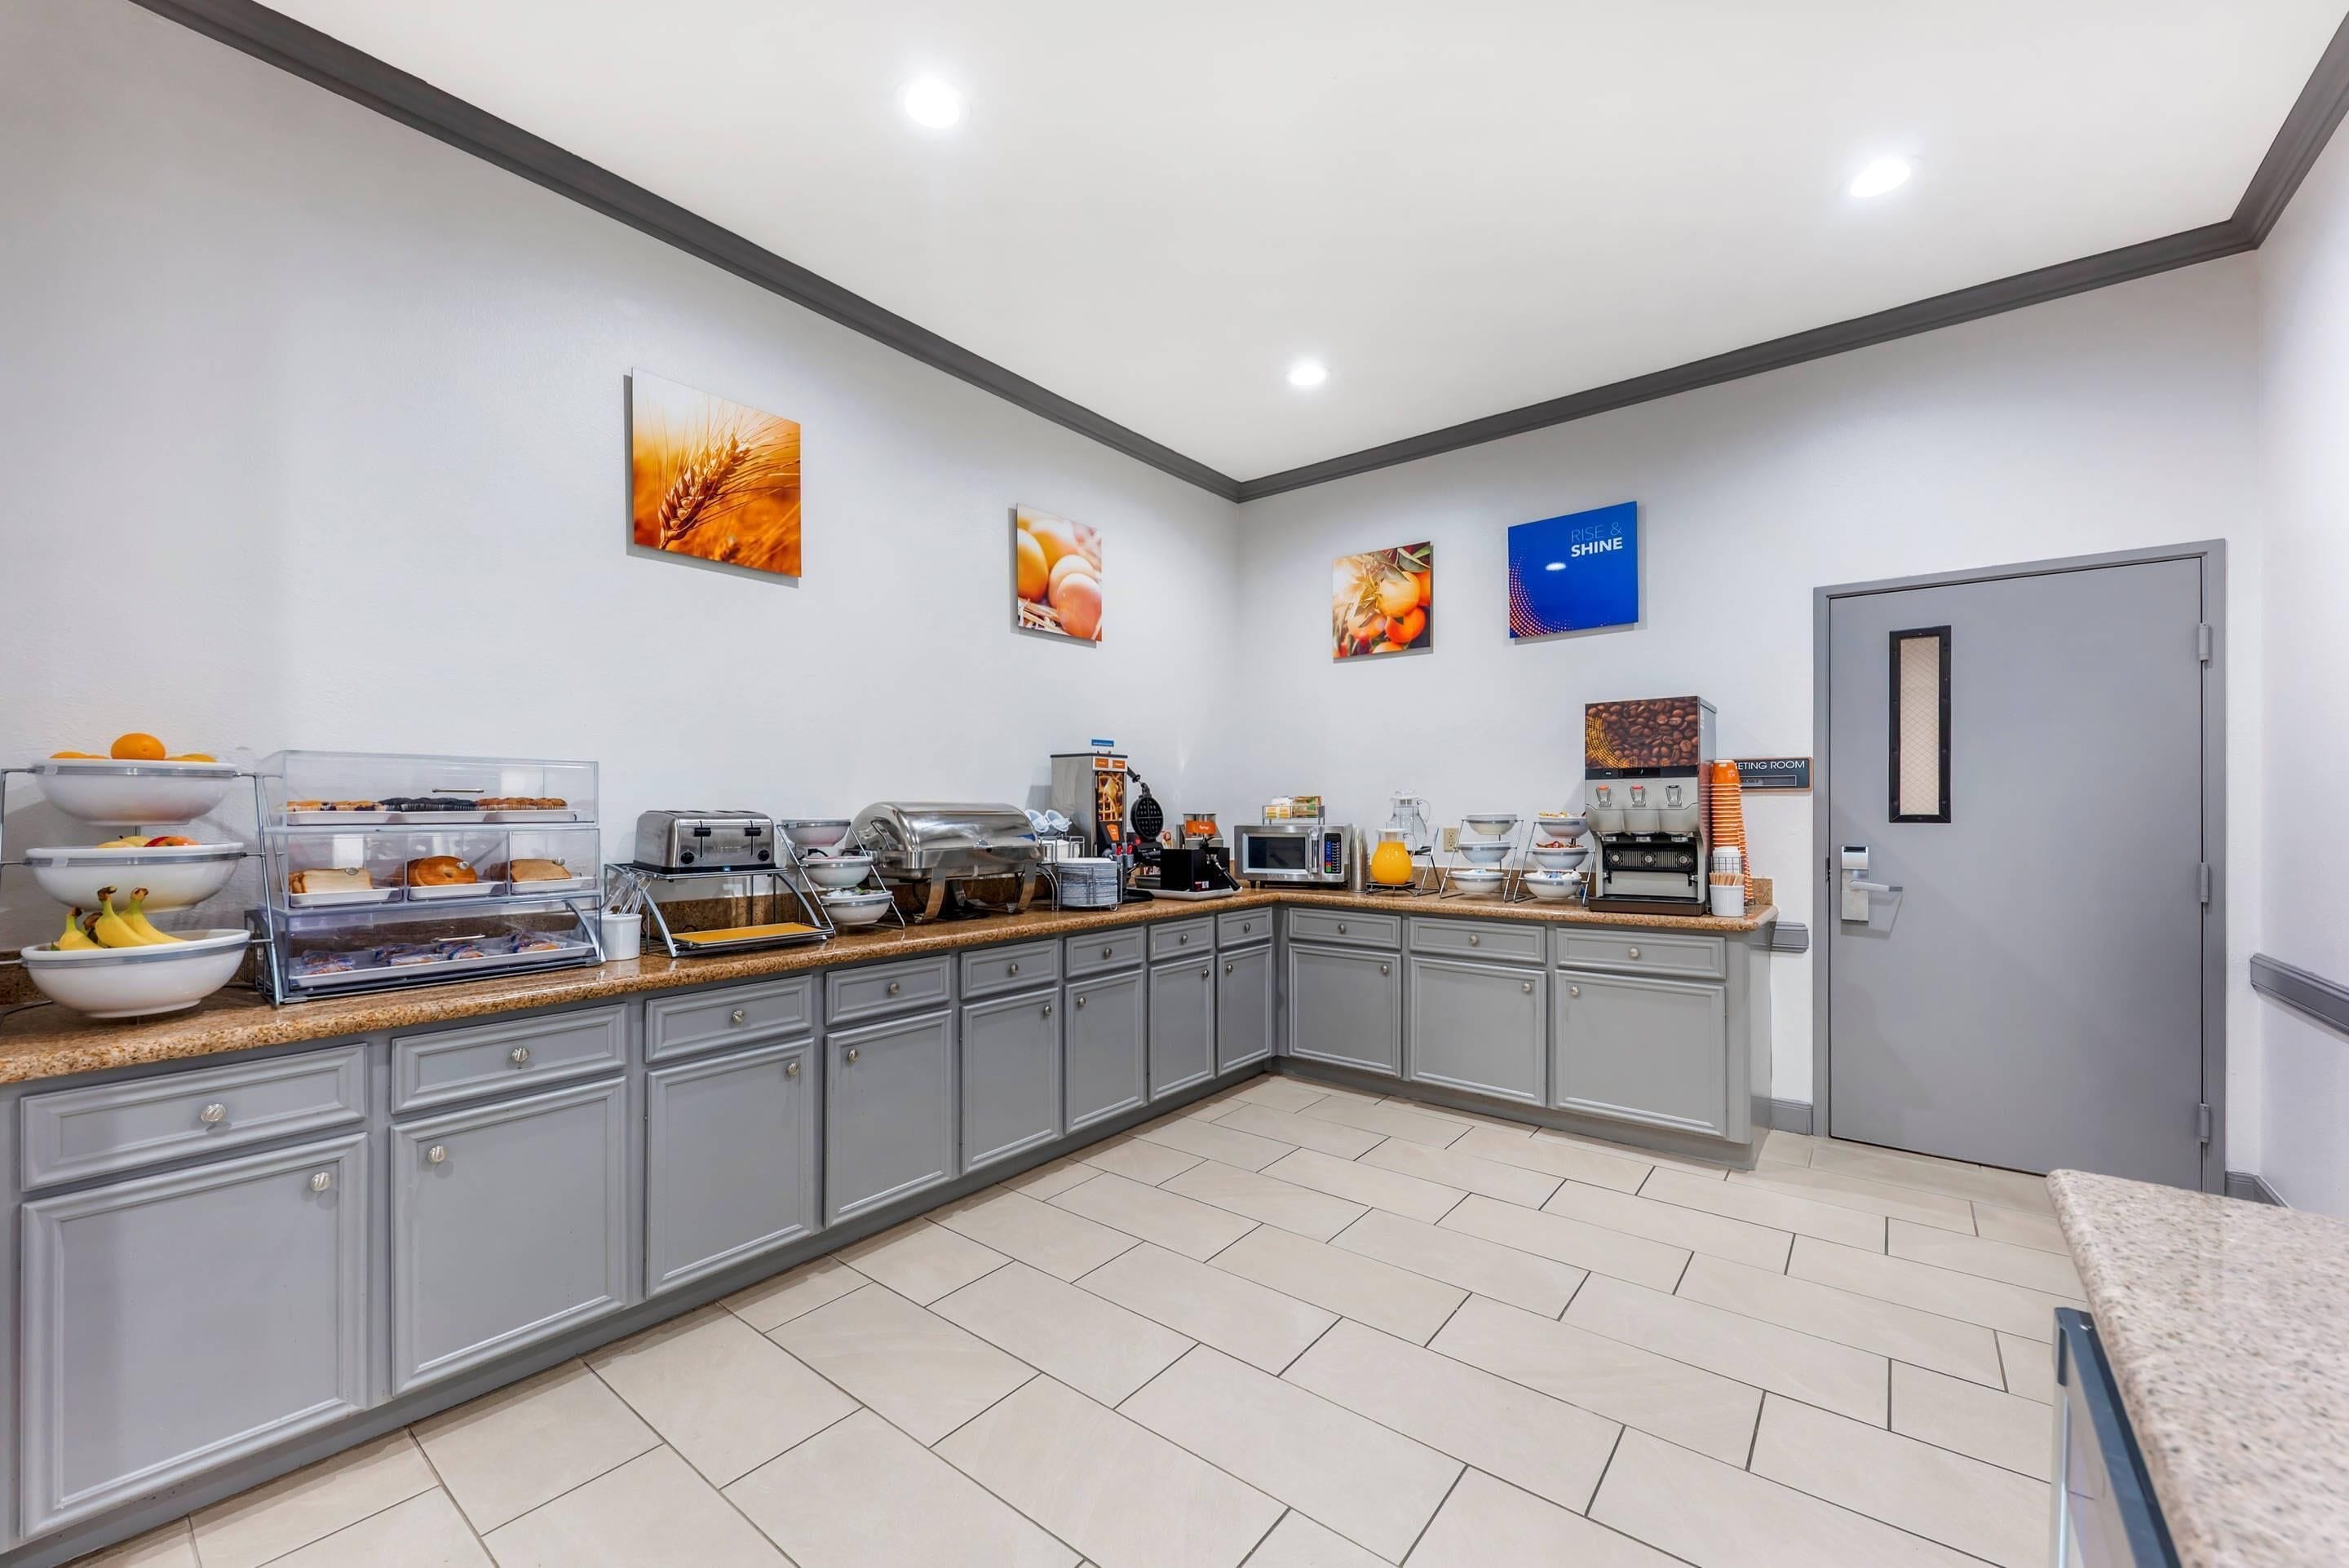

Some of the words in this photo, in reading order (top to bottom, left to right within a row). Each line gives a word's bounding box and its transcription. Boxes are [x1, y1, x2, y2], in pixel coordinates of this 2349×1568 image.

[1571, 524, 1604, 544] RISE
[1610, 521, 1622, 536] &
[1570, 537, 1623, 558] SHINE
[1735, 762, 1767, 771] ETING
[1770, 760, 1805, 770] ROOM
